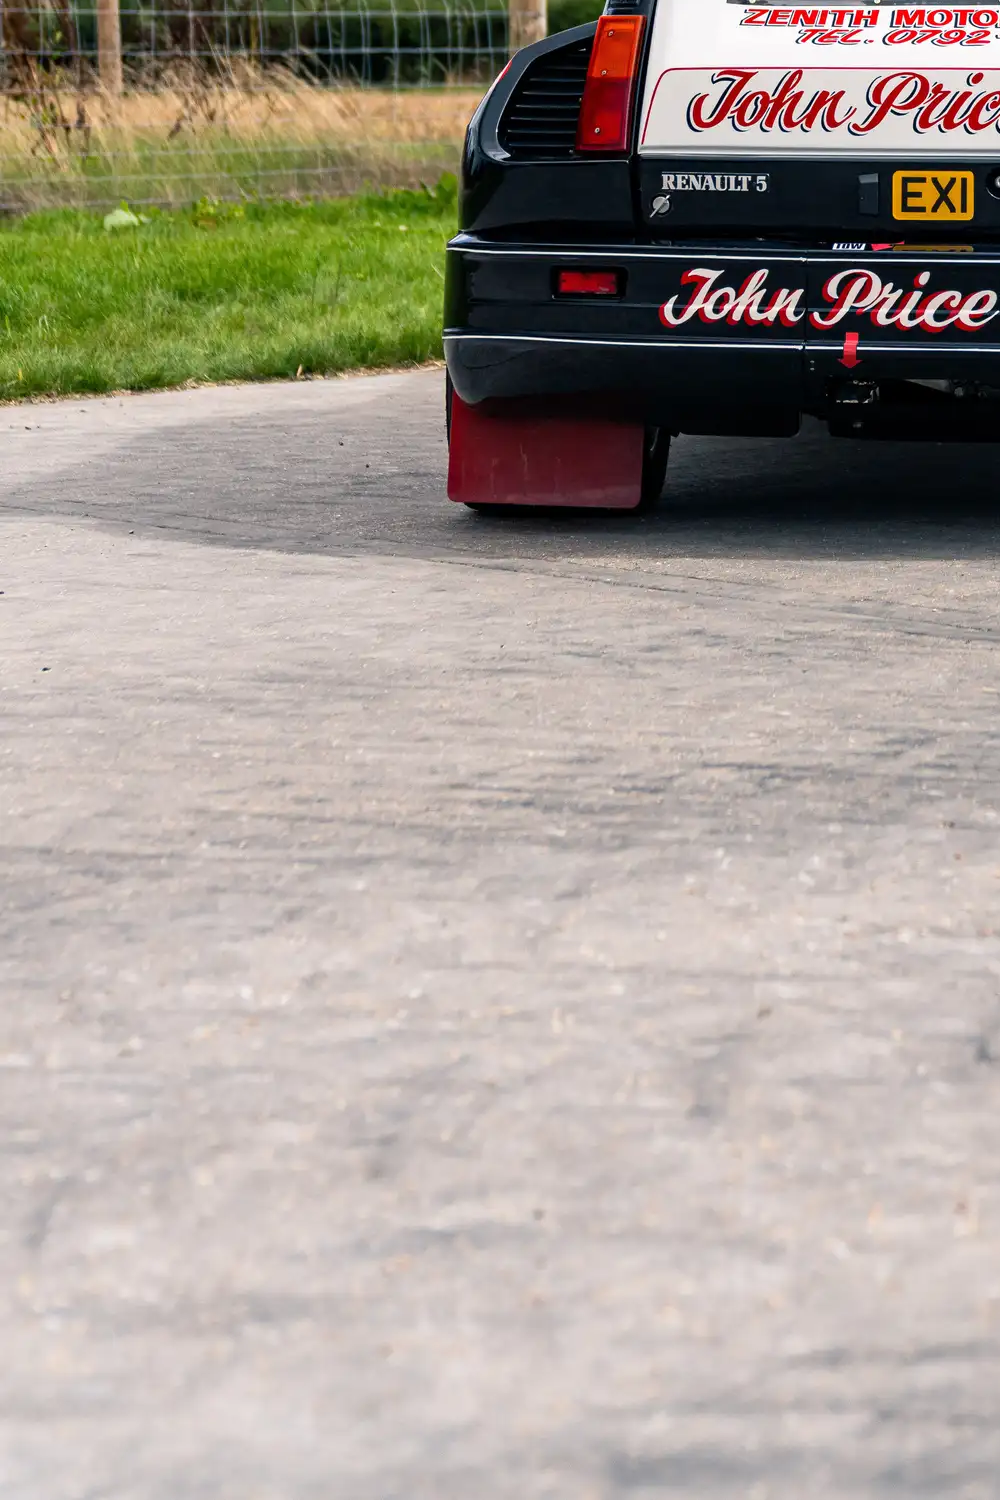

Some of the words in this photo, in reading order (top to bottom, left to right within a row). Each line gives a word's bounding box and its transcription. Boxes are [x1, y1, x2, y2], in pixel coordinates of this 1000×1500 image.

[739, 8, 880, 27] ZENITH
[796, 29, 875, 45] TEL.
[686, 69, 857, 133] John
[661, 173, 751, 192] RENAULT
[756, 175, 768, 193] 5
[900, 176, 968, 214] EXI
[659, 268, 806, 329] John
[809, 268, 1000, 333] Price
